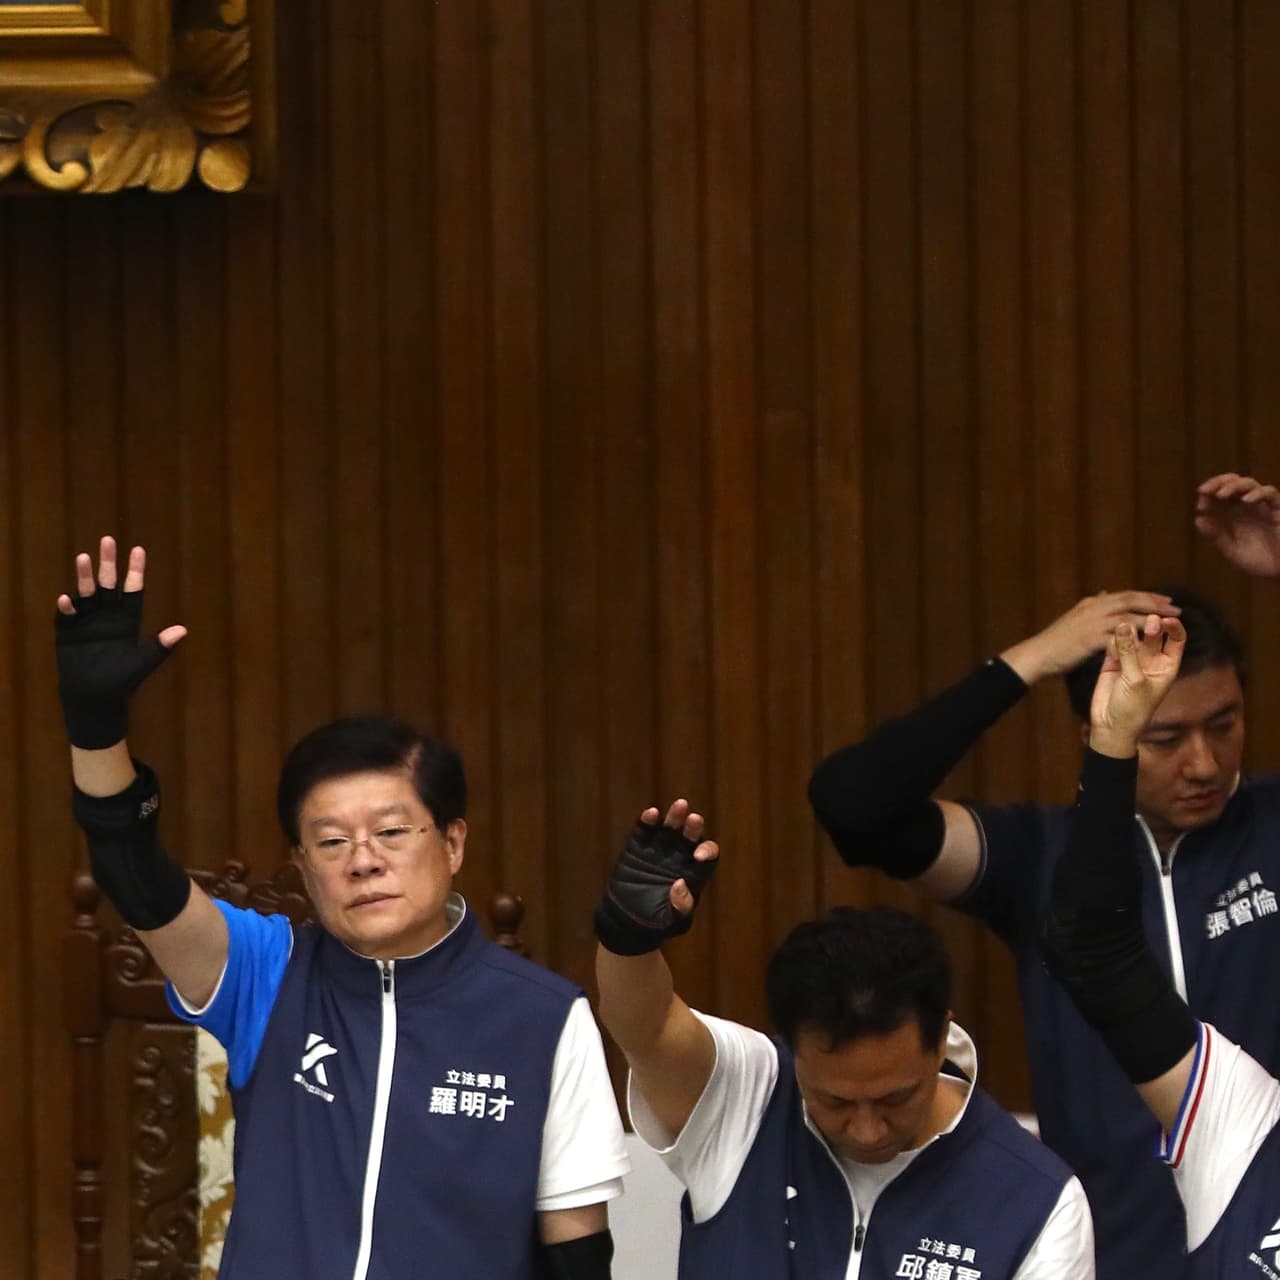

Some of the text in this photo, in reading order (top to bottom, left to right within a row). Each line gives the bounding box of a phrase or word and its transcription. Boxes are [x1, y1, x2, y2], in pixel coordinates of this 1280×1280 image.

[1206, 888, 1279, 939] 張智倫
[446, 1069, 506, 1090] 立法委員
[429, 1086, 515, 1122] 羅明才
[917, 1237, 976, 1264] 立法委員
